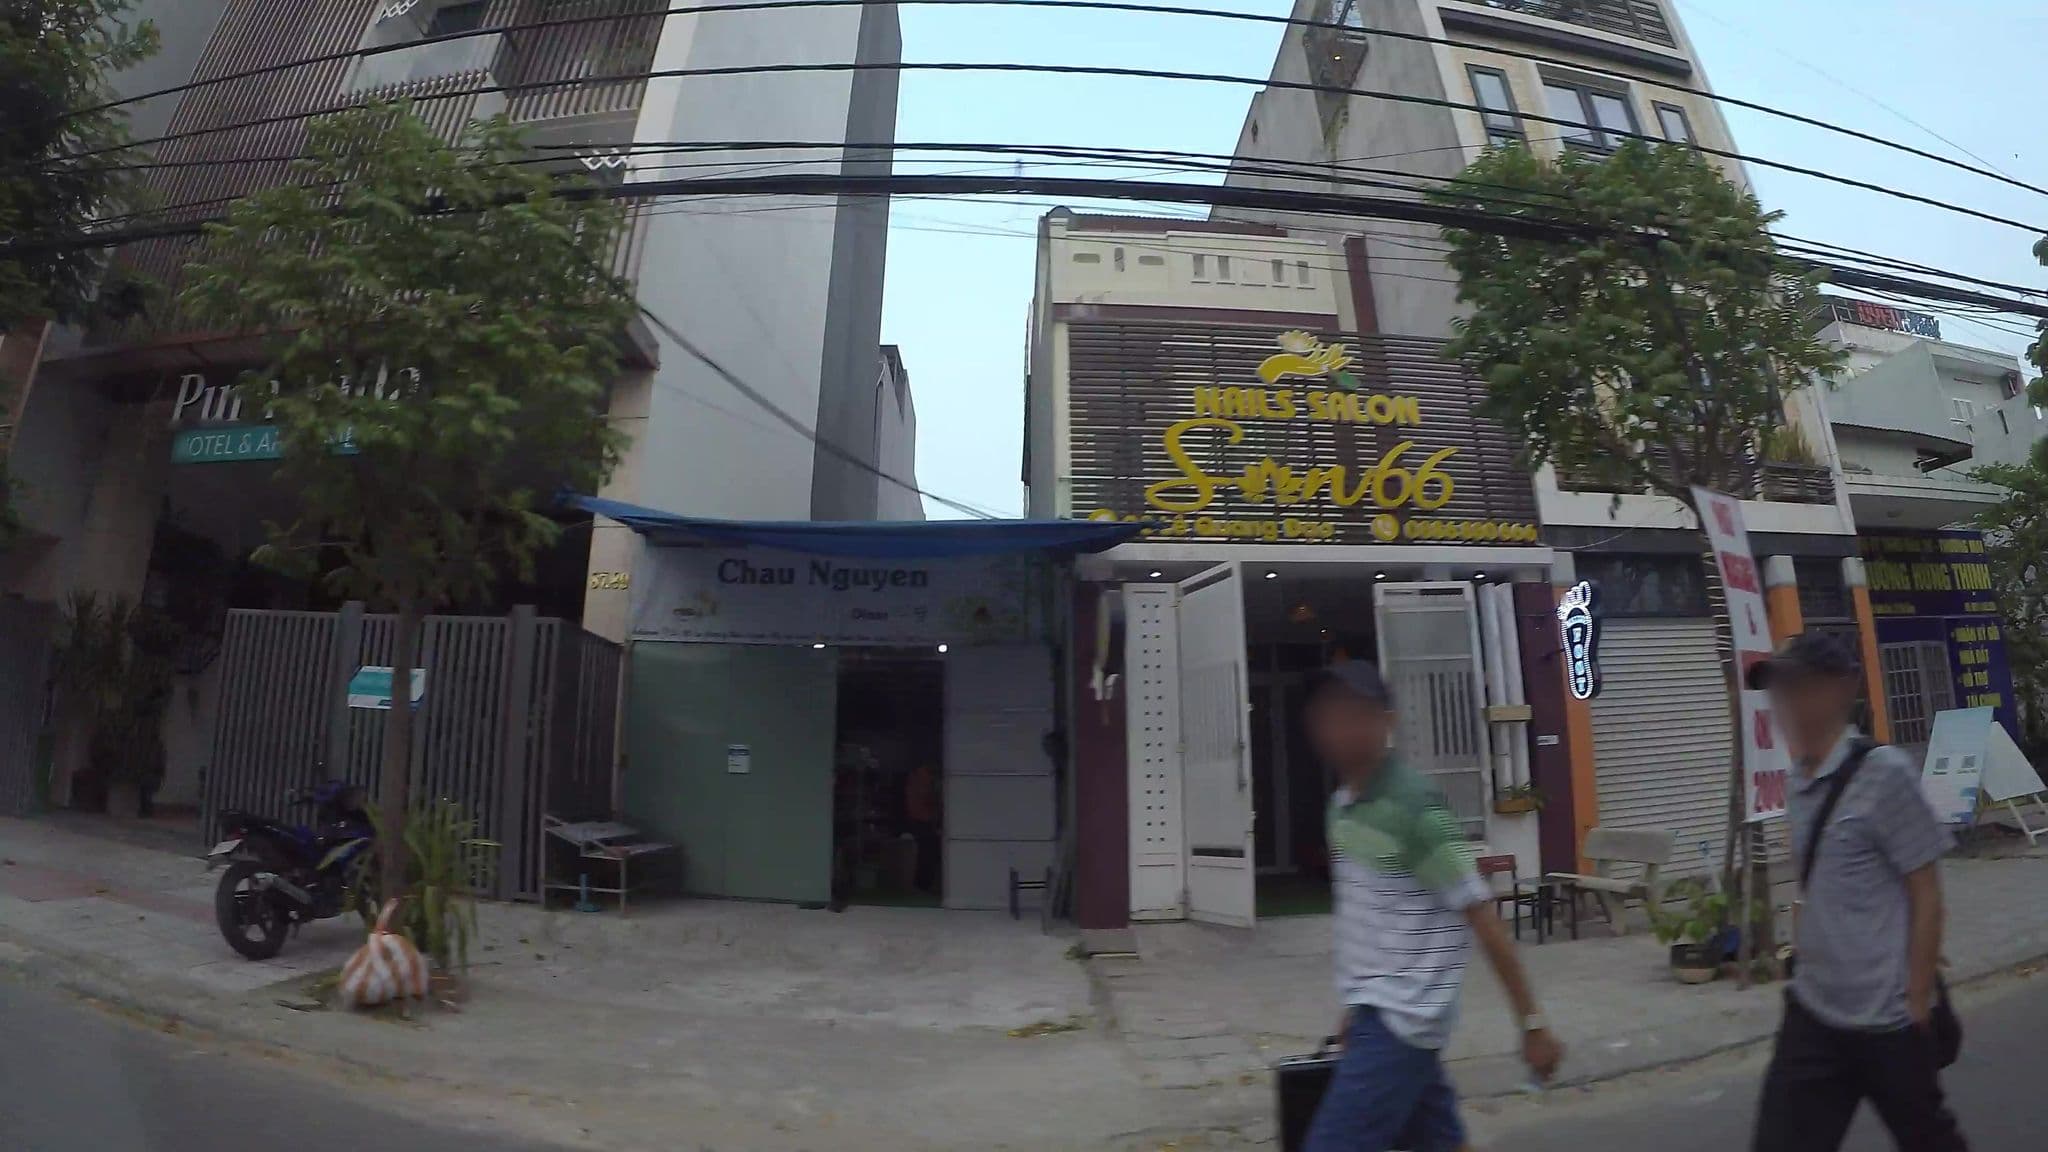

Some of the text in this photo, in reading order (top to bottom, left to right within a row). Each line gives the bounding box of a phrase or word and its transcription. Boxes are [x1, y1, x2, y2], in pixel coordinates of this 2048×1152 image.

[1194, 386, 1422, 426] NAILS SALON
[718, 558, 929, 592] Chau Nguyen
